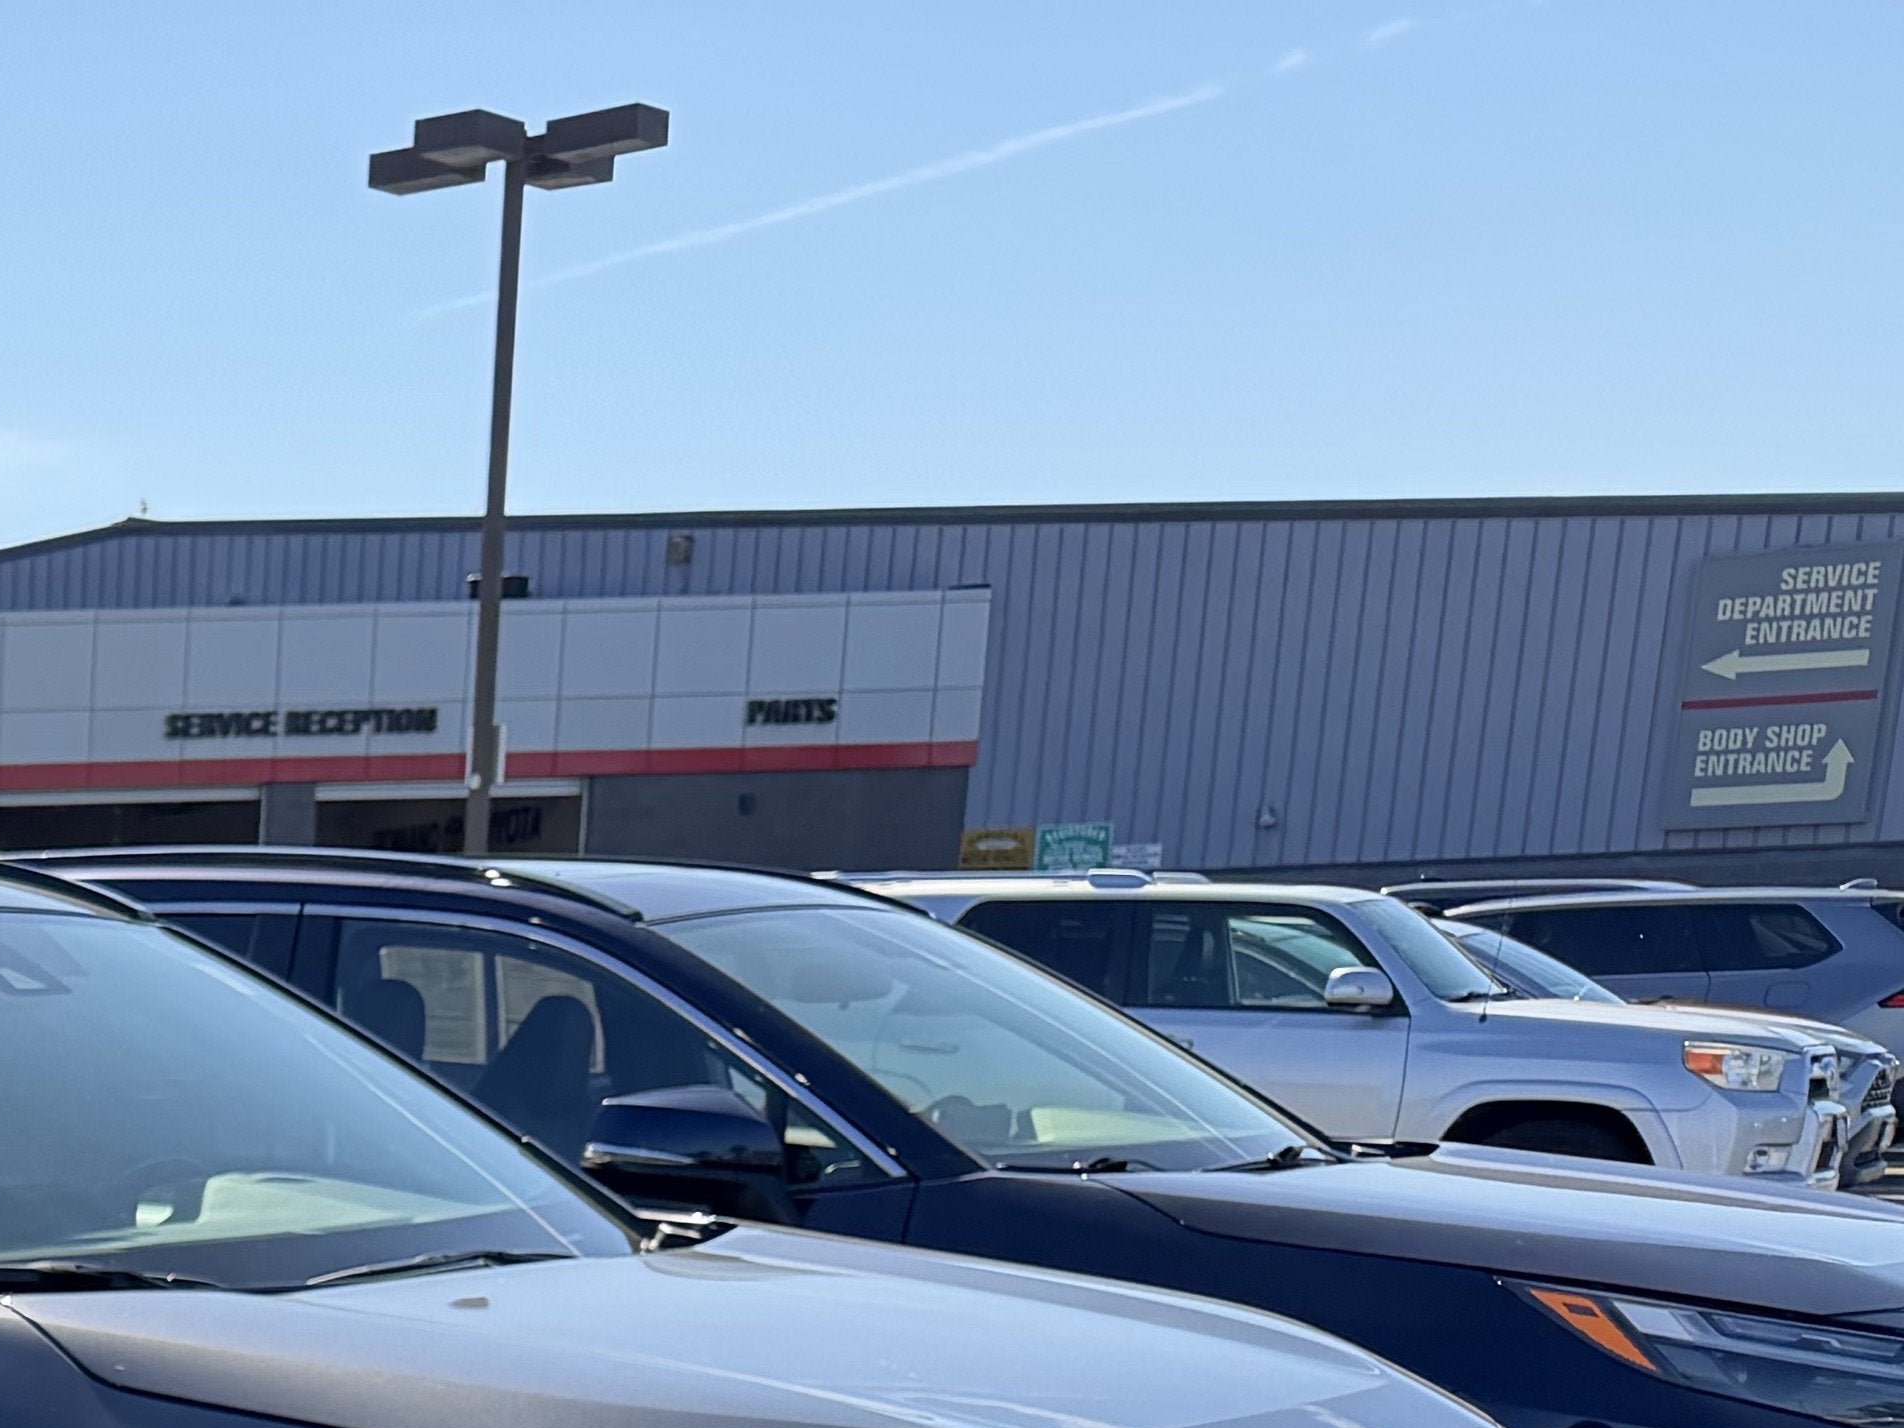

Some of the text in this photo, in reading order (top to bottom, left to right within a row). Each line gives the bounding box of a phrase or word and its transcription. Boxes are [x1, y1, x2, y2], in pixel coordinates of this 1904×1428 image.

[1780, 561, 1882, 590] SERVICE
[1717, 589, 1878, 621] DEPARTMENT
[1745, 615, 1873, 645] ENTRANCE
[165, 706, 438, 739] SERVICE RECEPTION
[747, 698, 837, 725] PARTS
[1698, 724, 1827, 751] BODY SHOP
[1694, 750, 1813, 777] ENTRANCE
